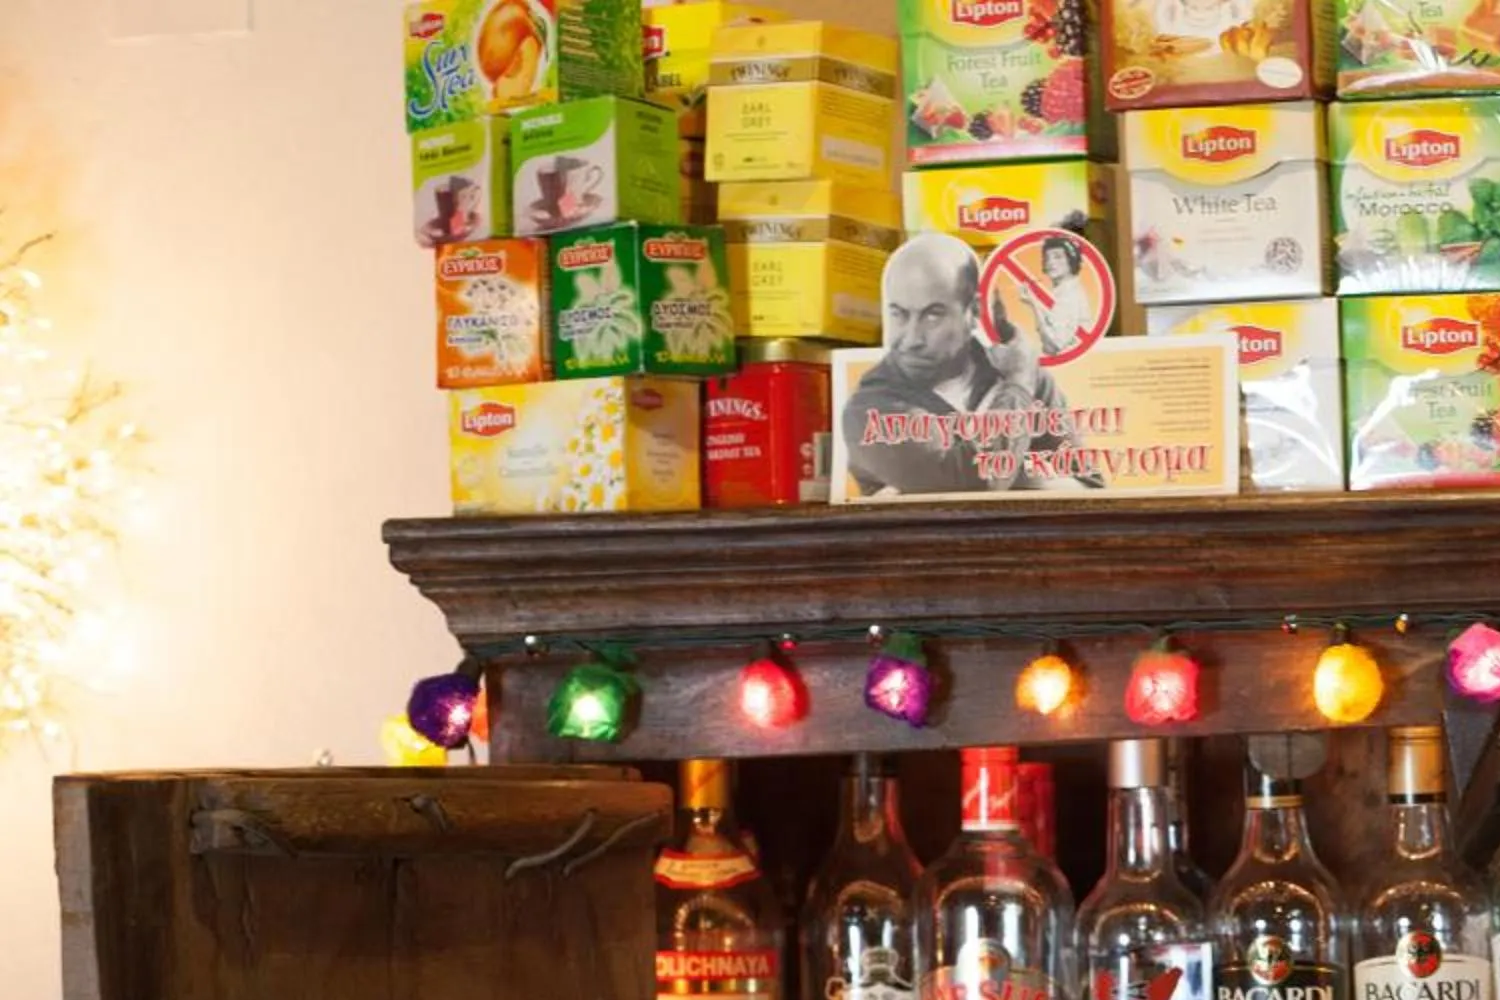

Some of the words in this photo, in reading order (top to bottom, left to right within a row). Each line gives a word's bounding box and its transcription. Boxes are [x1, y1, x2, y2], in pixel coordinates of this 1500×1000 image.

[956, 0, 1020, 20] Lipton
[1001, 49, 1042, 68] Fruit
[979, 71, 1009, 89] Tea
[1186, 136, 1253, 158] Lipton
[1389, 139, 1457, 161] Lipton
[1172, 195, 1240, 216] White
[1243, 193, 1277, 212] Tea
[1359, 201, 1454, 218] Morocco
[961, 206, 1027, 229] Lipton
[1240, 335, 1278, 353] ton
[1407, 327, 1474, 349] Lipton
[706, 397, 767, 421] ININGS
[1425, 401, 1457, 419] Tea
[464, 411, 513, 433] Lipton
[656, 954, 770, 977] OLICHNAYA
